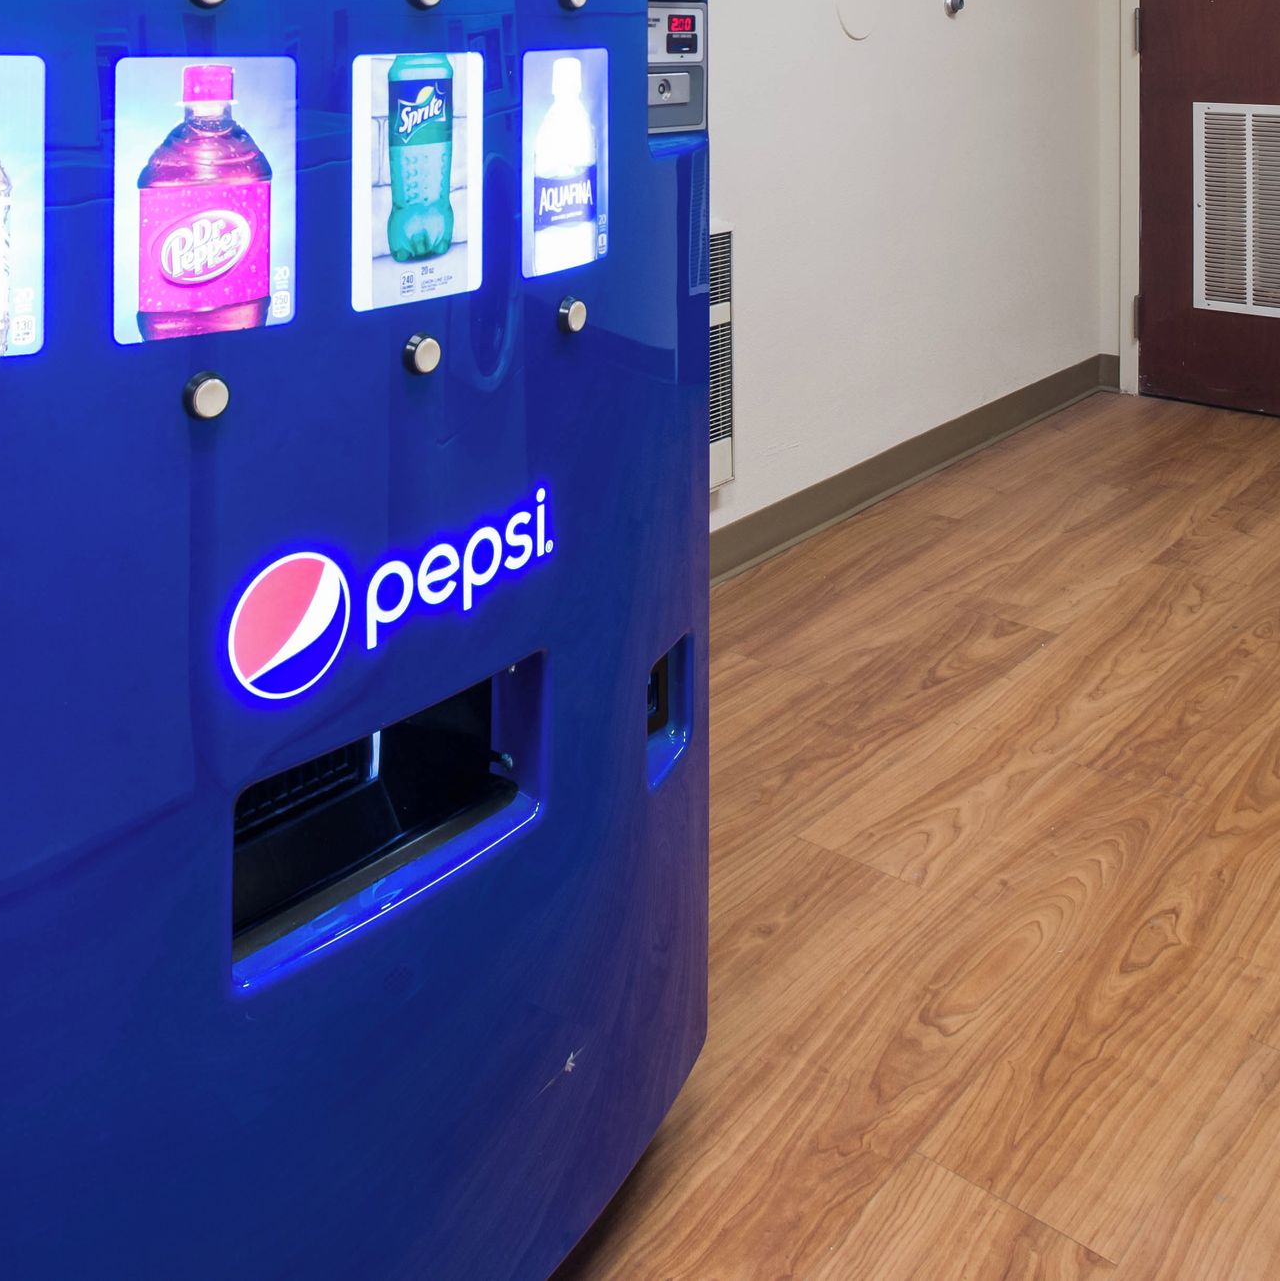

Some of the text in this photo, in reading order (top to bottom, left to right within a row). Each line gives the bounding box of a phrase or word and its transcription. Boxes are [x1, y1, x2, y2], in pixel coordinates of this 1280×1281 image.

[398, 94, 443, 134] Sprite
[538, 179, 594, 216] AQUAFINA
[161, 226, 242, 278] Pepper
[191, 218, 225, 249] Dr
[365, 486, 546, 650] pepsi
